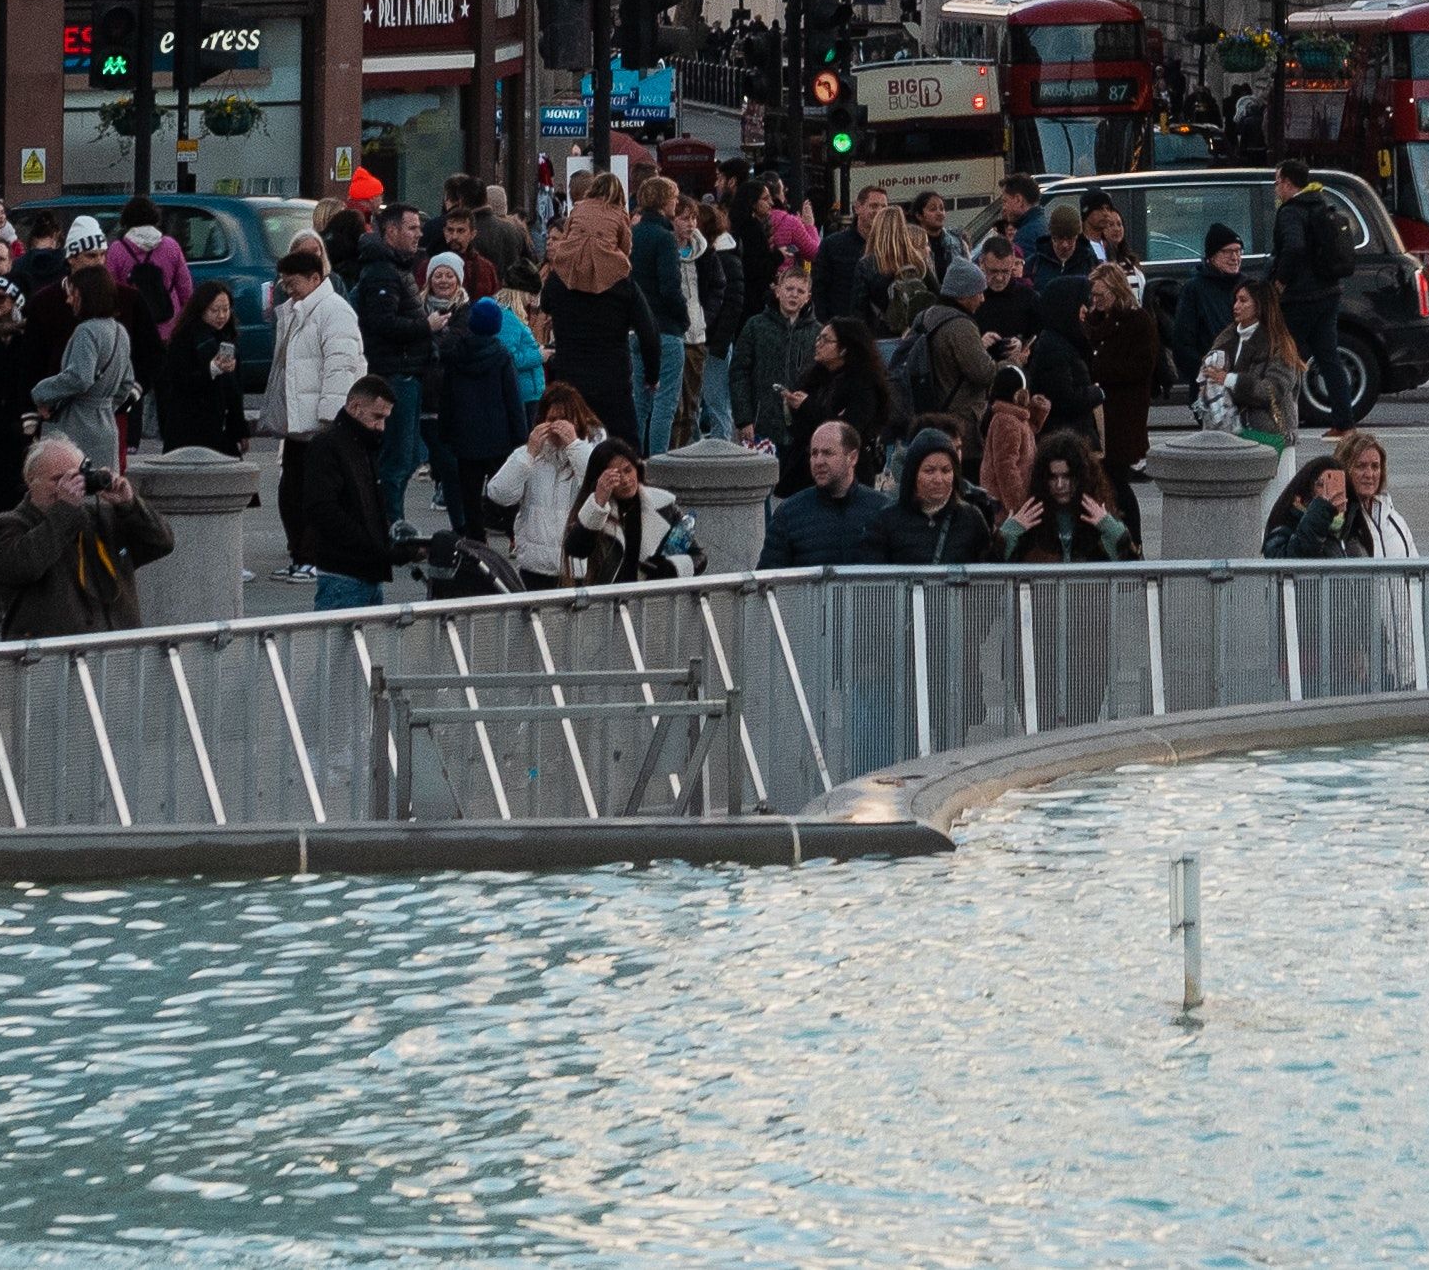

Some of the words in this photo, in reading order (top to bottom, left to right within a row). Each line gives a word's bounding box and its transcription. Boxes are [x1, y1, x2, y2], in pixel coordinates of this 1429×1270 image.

[888, 79, 918, 95] BIG
[1109, 84, 1128, 100] 87
[888, 95, 919, 110] BUS
[544, 109, 583, 119] MONEY
[542, 124, 587, 136] CHANGE
[878, 176, 916, 188] HOP-ON
[918, 173, 961, 185] HOP-OFF
